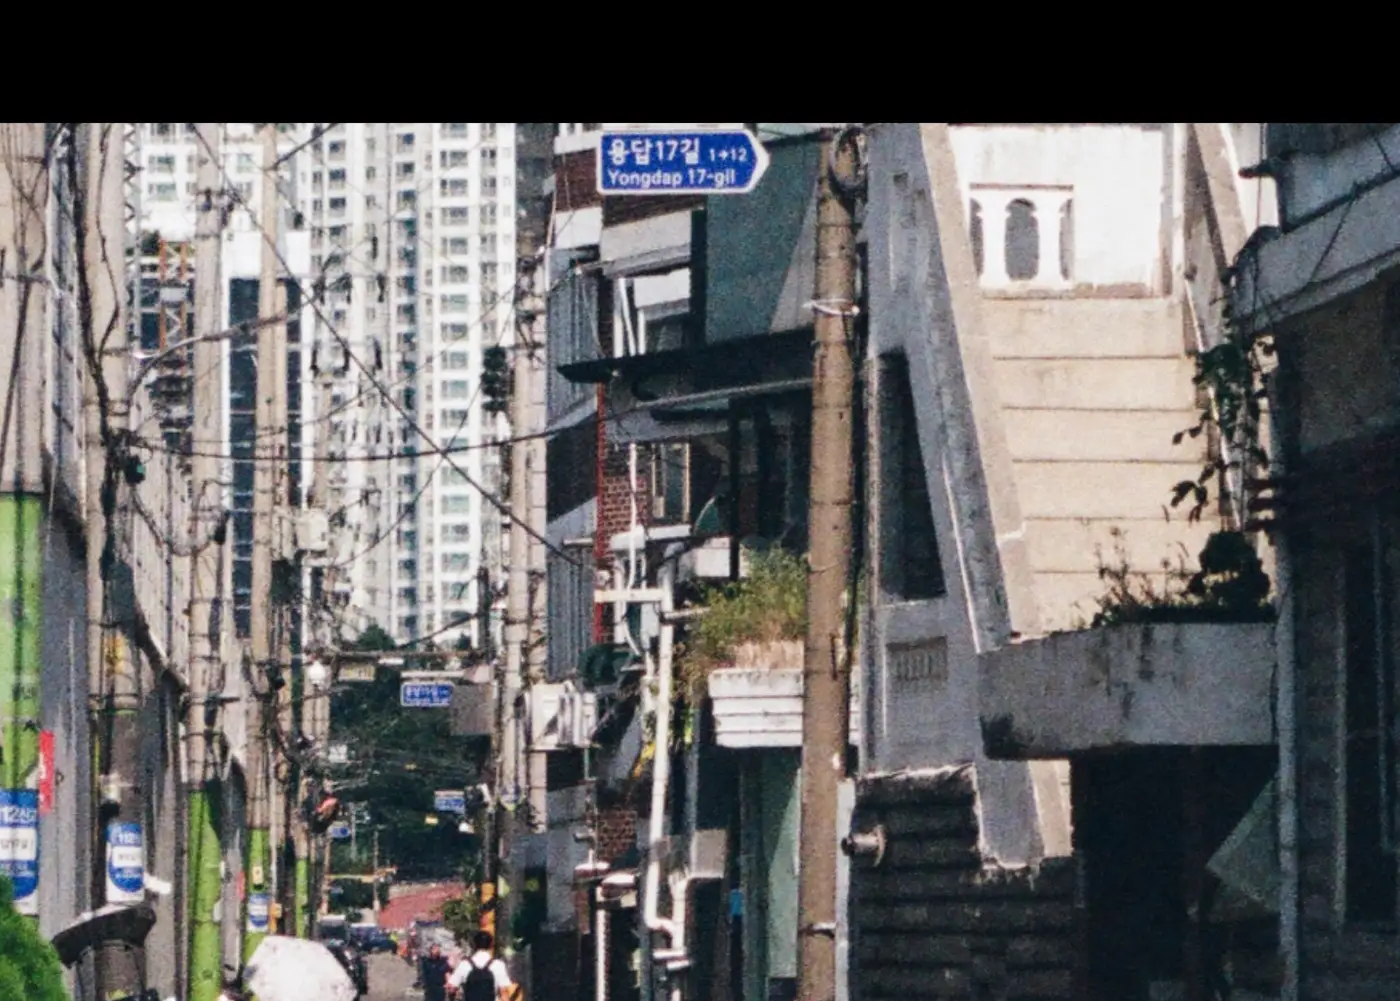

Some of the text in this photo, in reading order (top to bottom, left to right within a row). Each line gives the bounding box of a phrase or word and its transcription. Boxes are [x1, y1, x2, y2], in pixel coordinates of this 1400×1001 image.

[607, 137, 700, 166] 용답17길
[607, 167, 736, 190] Yongdap 17-gil
